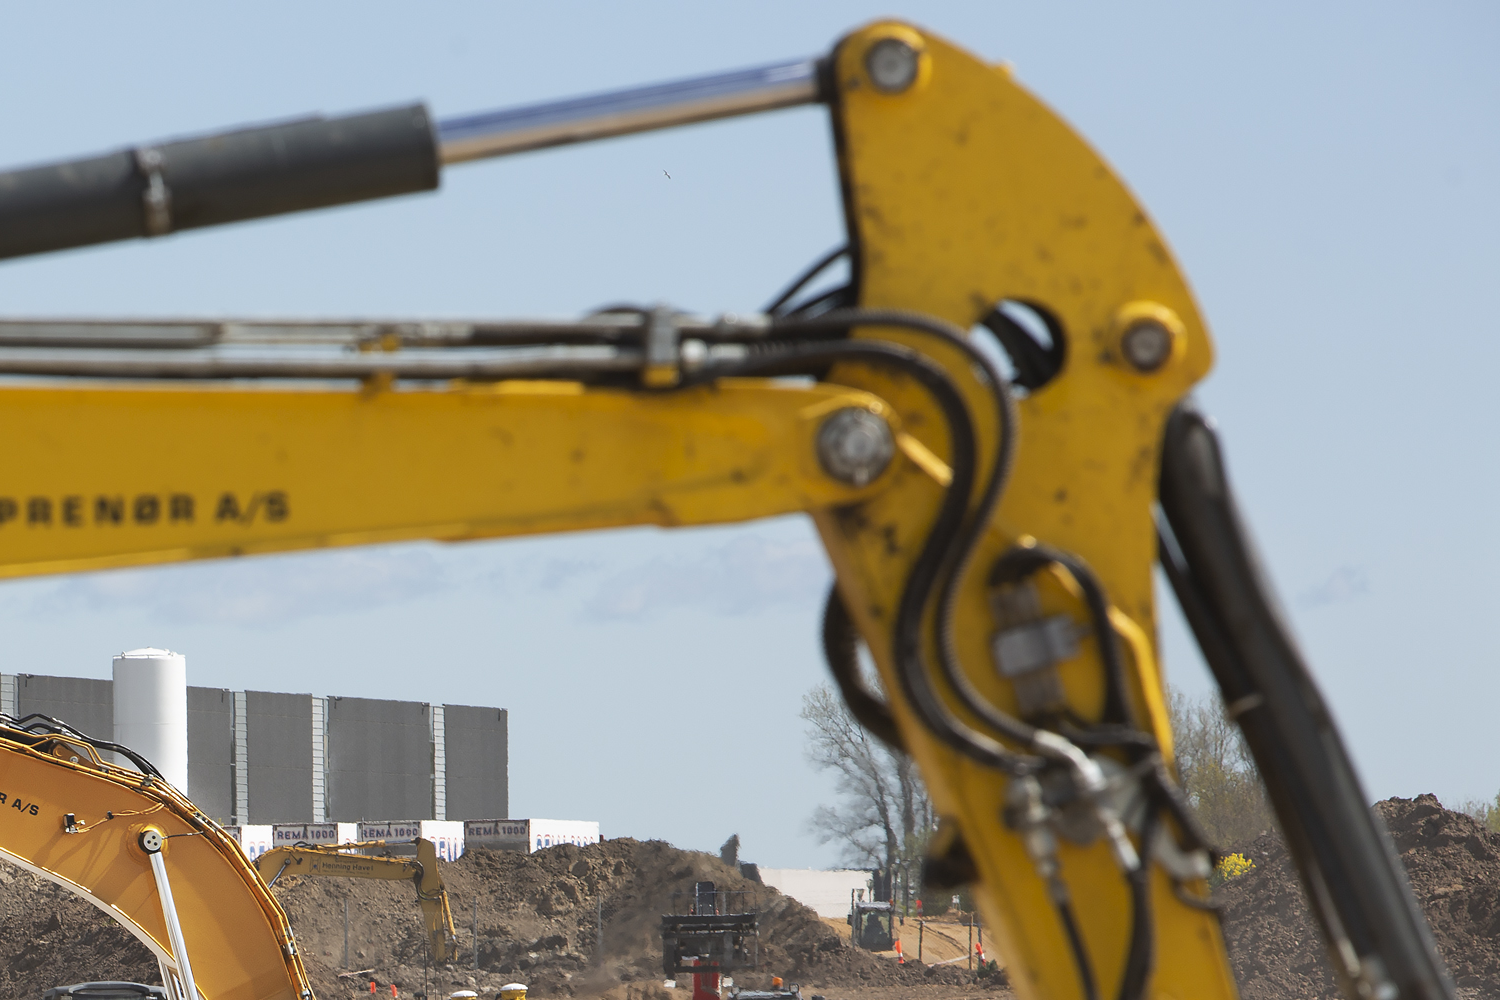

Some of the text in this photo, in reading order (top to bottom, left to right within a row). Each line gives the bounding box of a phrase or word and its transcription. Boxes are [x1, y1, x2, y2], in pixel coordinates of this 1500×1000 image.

[214, 490, 292, 529] A/S
[11, 797, 40, 817] A/S
[276, 829, 335, 840] REMA 1000
[363, 827, 419, 838] REMA 1000
[468, 826, 526, 836] REMA 1000
